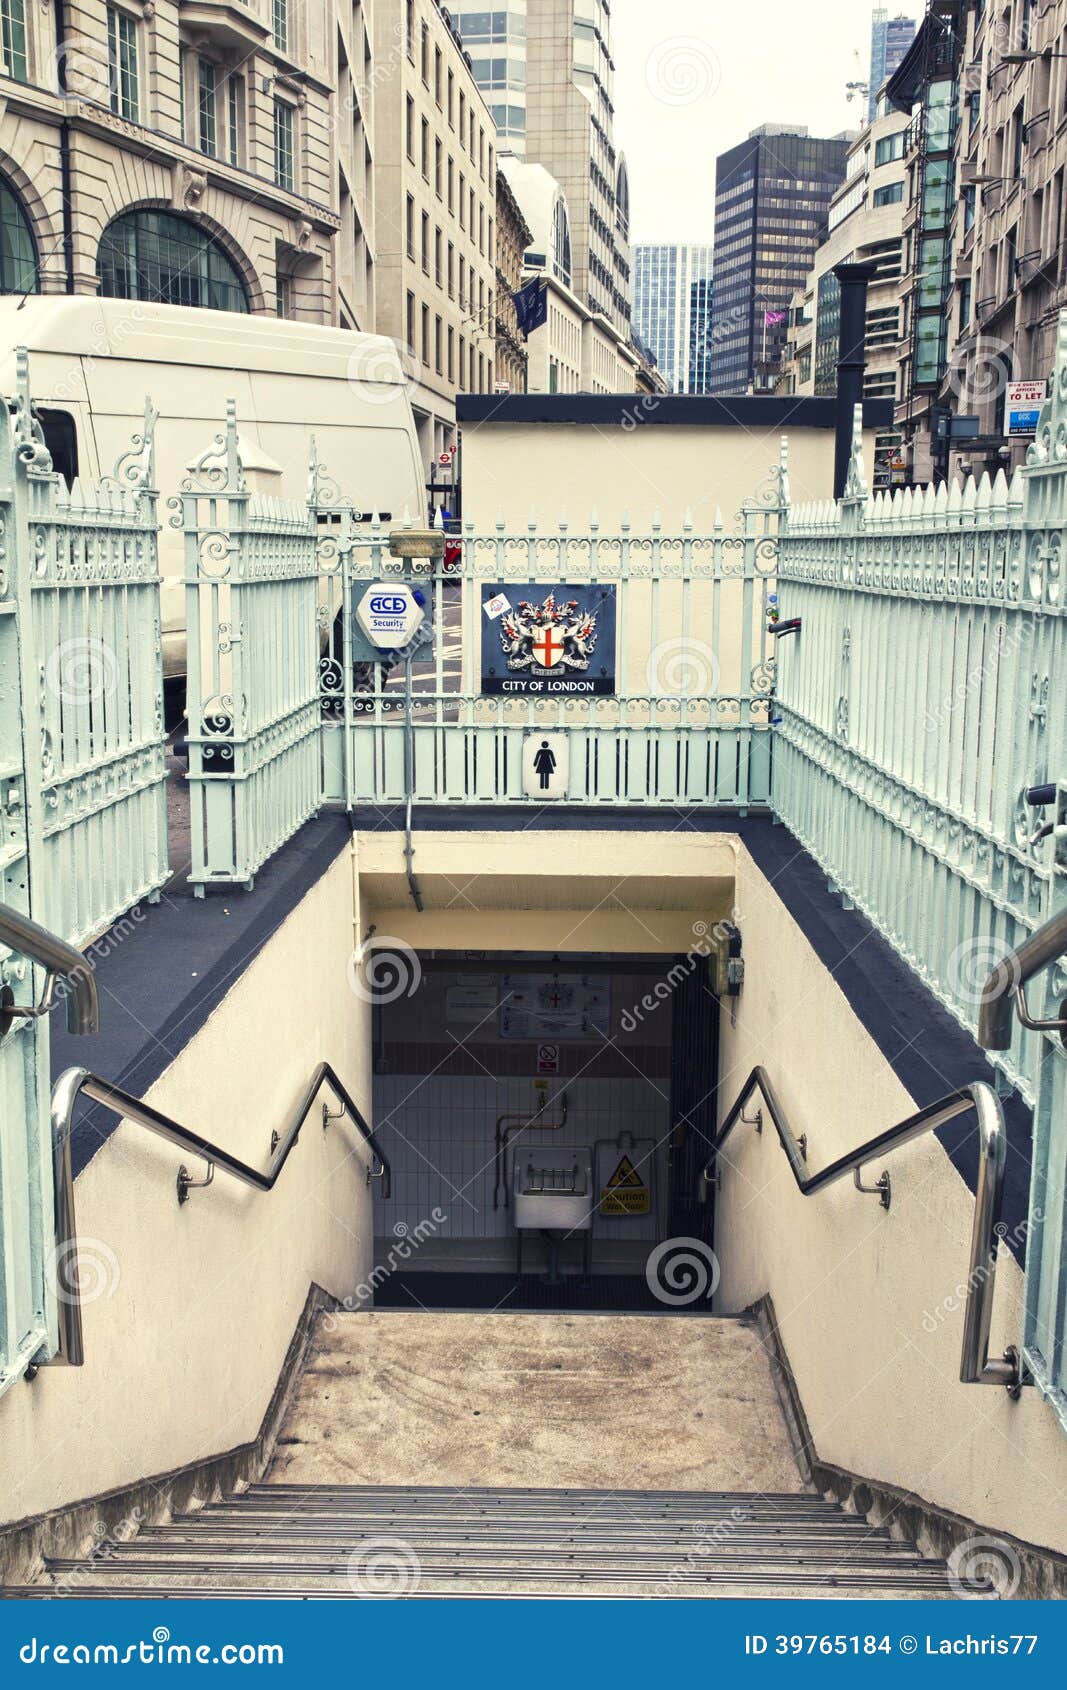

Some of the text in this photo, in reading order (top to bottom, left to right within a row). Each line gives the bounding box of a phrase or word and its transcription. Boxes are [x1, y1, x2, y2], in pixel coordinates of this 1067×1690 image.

[1025, 392, 1042, 400] LET
[370, 597, 407, 614] ACE
[373, 619, 403, 628] Security
[502, 681, 595, 691] CITY OF LONDON
